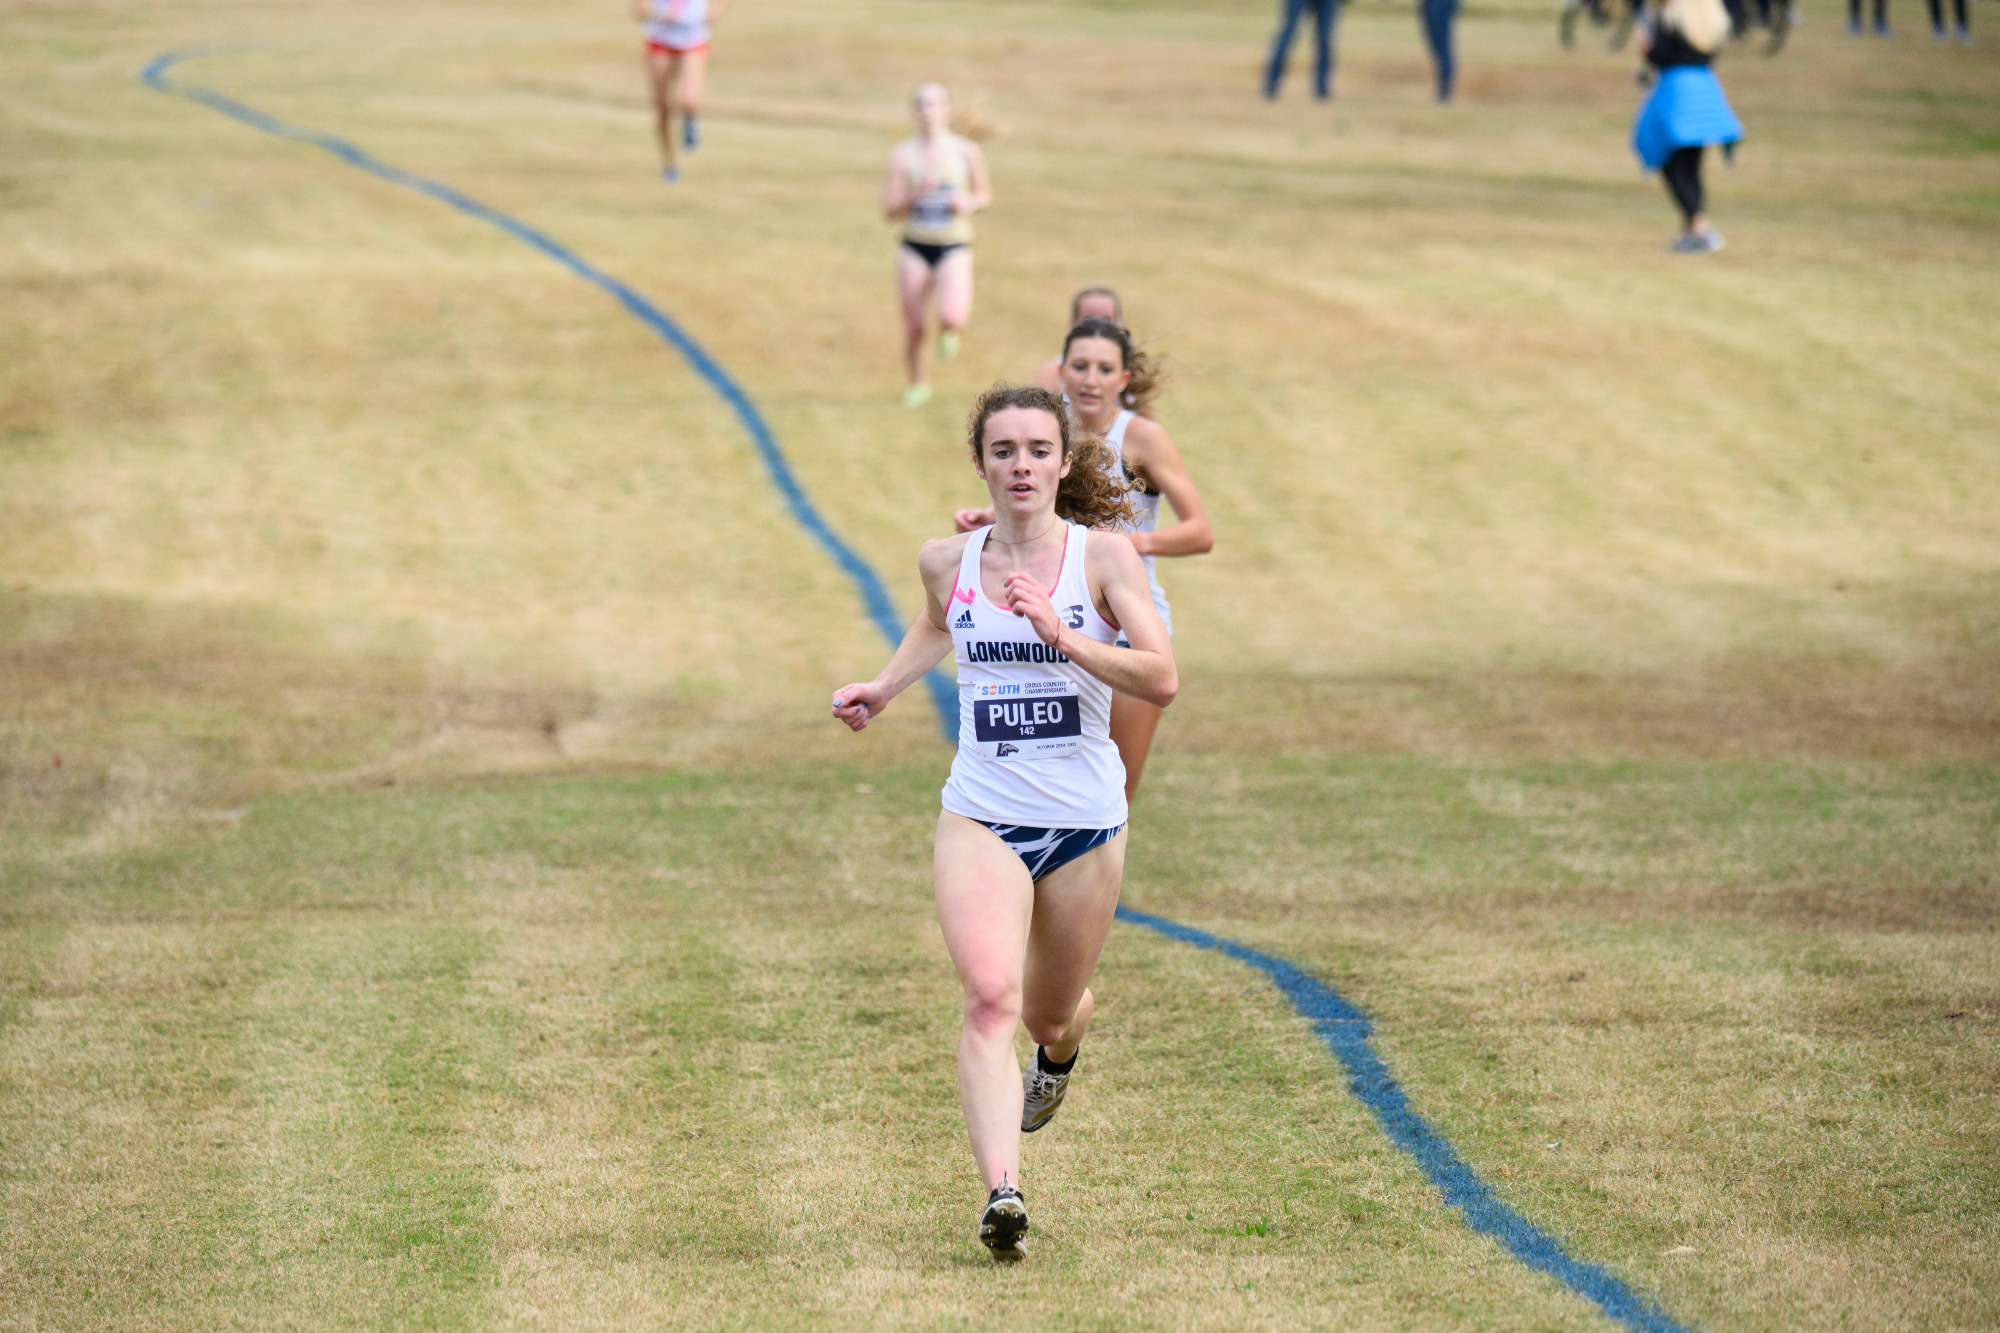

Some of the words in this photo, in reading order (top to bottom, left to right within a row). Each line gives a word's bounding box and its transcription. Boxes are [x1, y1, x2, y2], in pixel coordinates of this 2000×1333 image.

[955, 621, 975, 629] adidas
[1024, 687, 1067, 695] CHAMPIONSHIPS
[988, 700, 1063, 727] PULEO
[1019, 727, 1035, 736] 142
